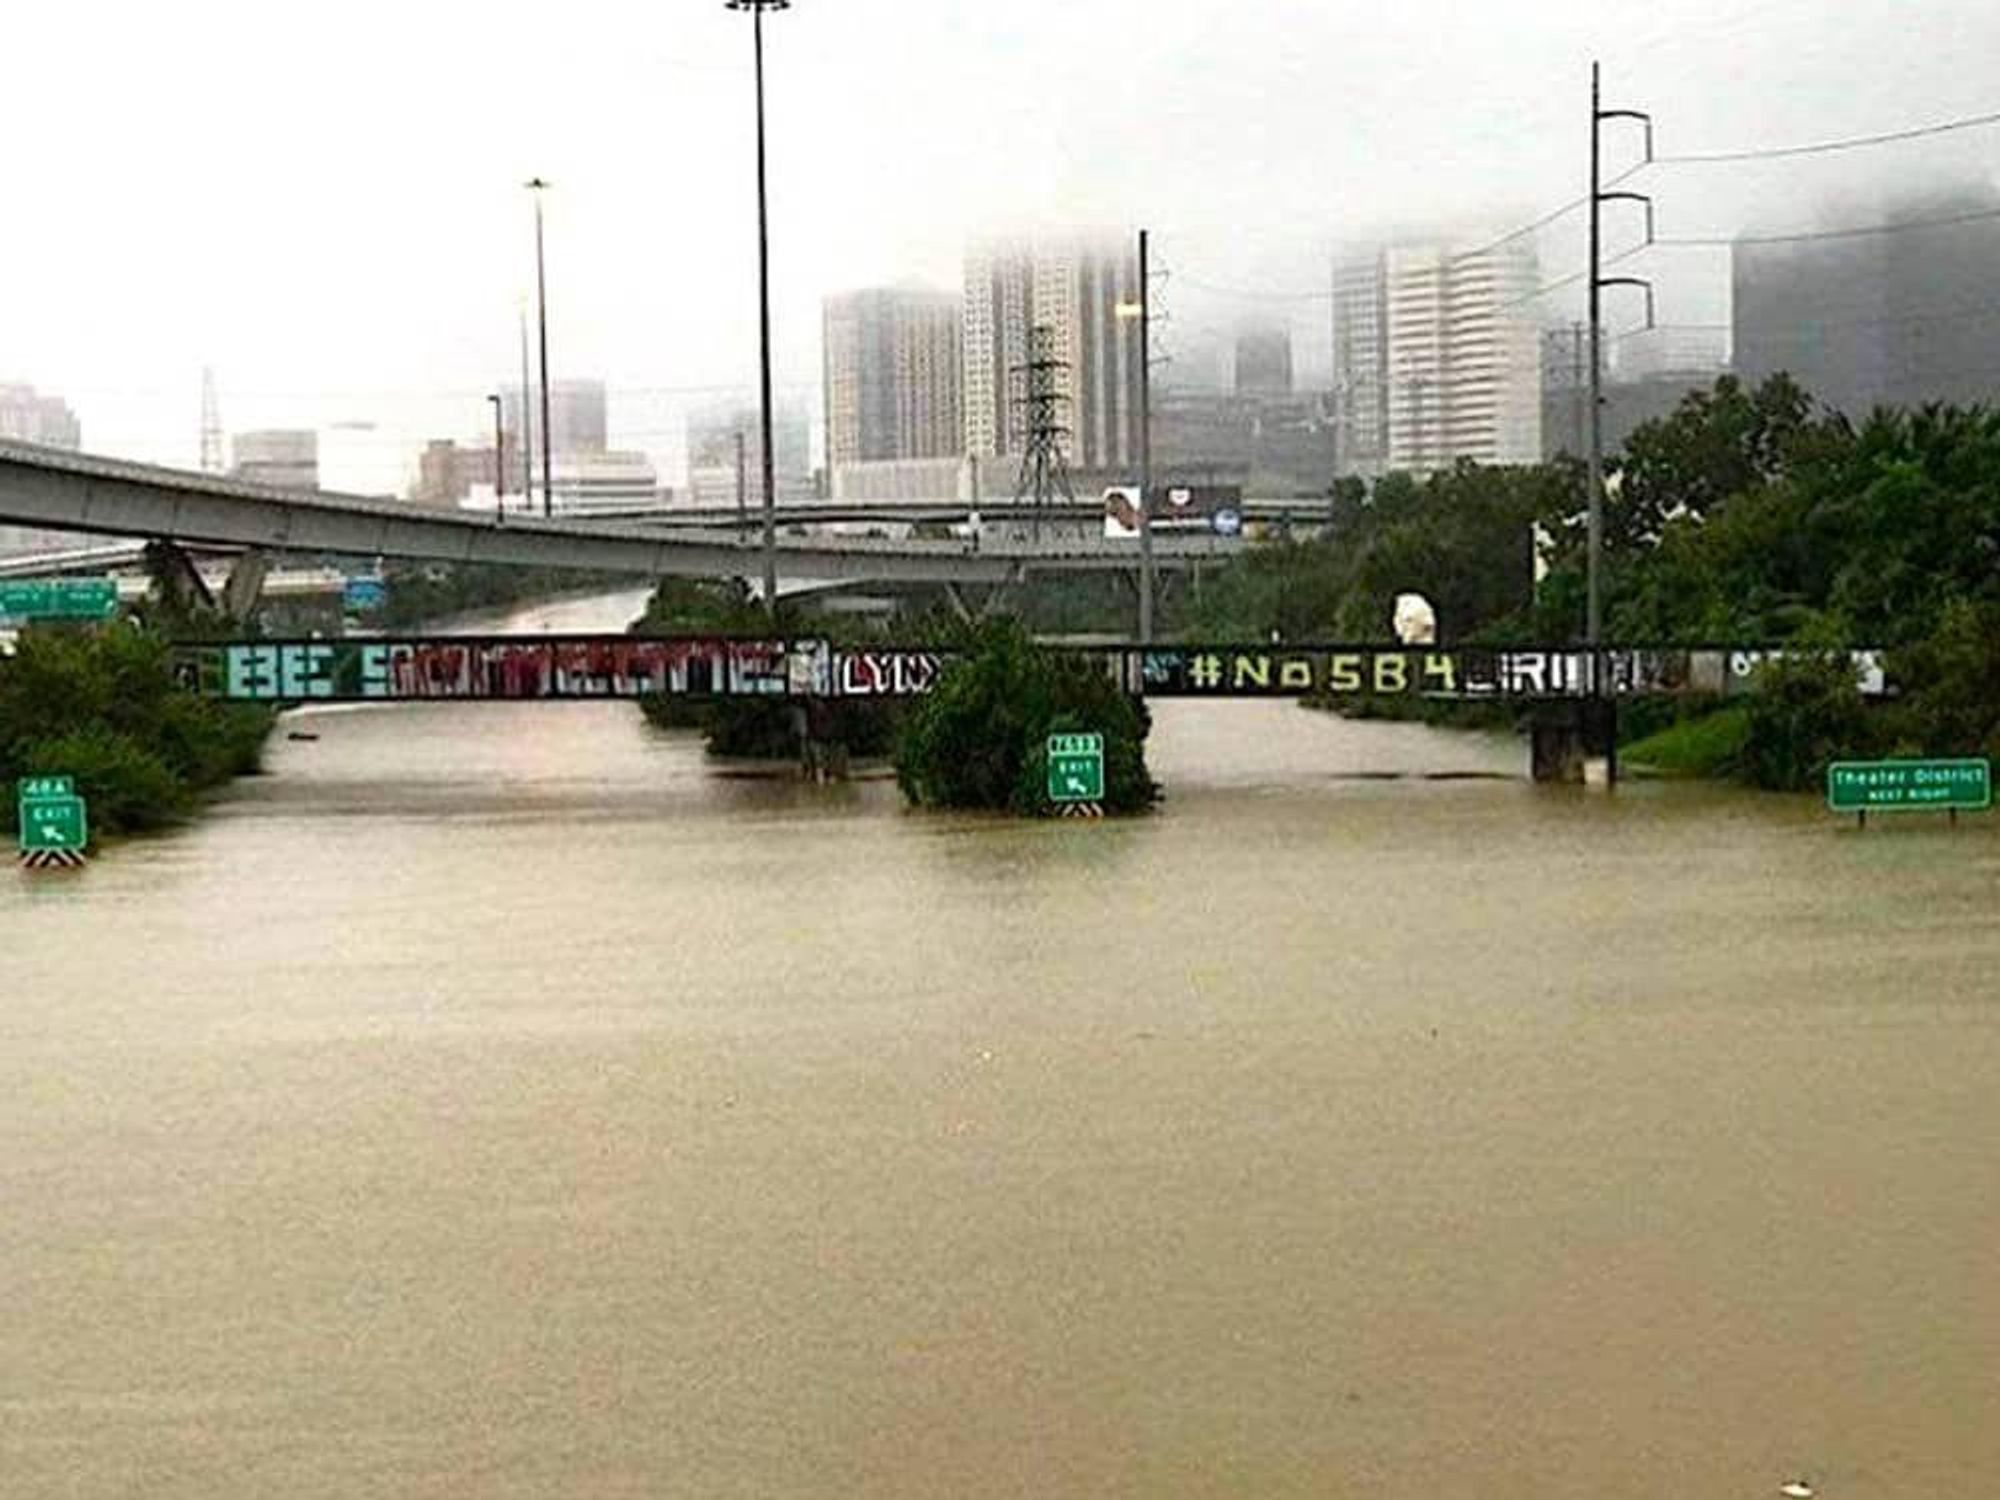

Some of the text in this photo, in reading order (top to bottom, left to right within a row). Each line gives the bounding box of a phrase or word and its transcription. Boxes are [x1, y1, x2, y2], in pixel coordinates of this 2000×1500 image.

[227, 646, 333, 696] BE
[1836, 768, 1983, 785] Theater District
[33, 807, 71, 821] EXIT
